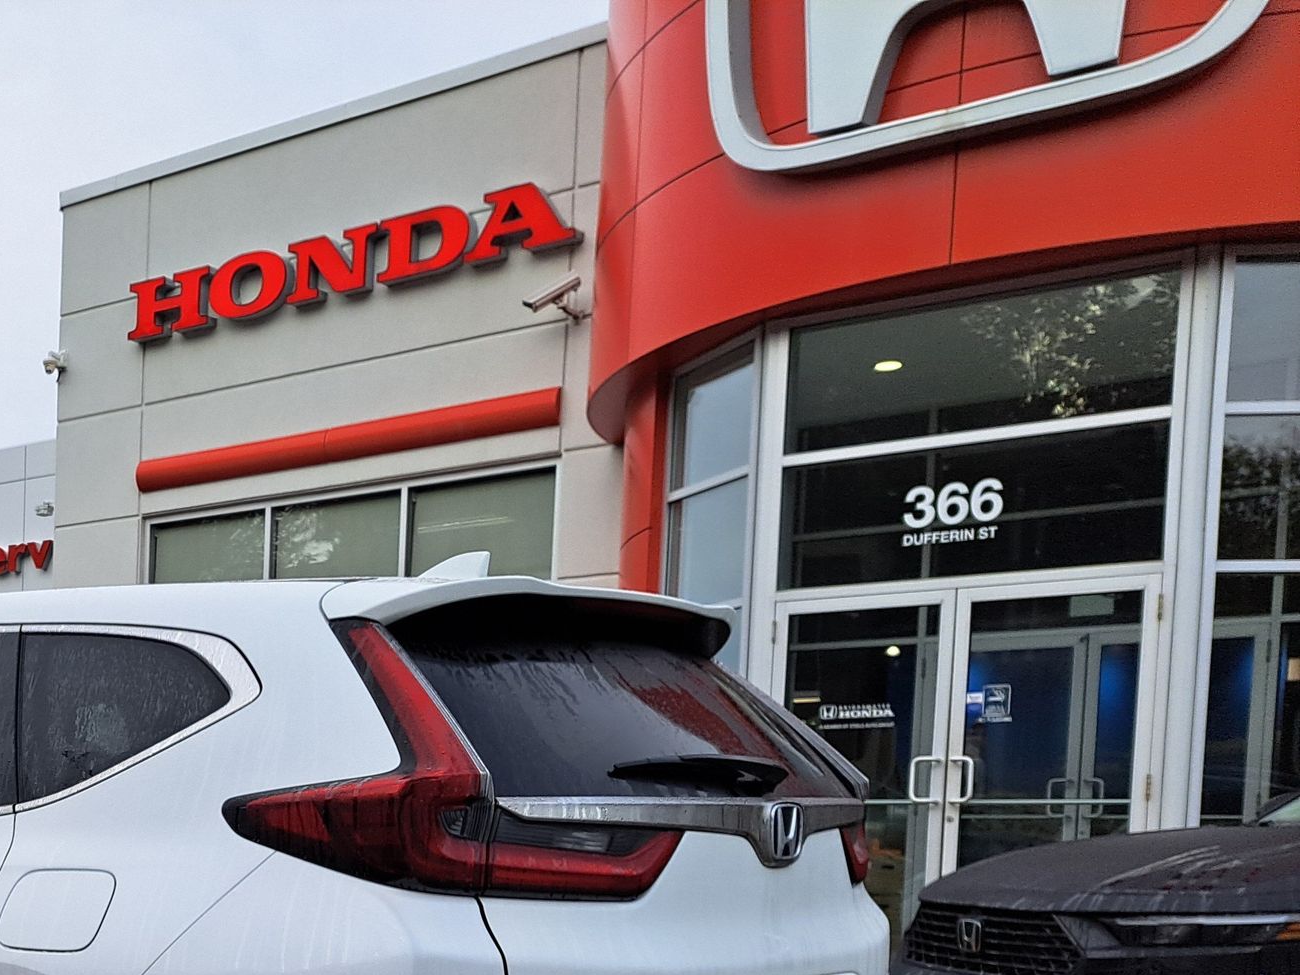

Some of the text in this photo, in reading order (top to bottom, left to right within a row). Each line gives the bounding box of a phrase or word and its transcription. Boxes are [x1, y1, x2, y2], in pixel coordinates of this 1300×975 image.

[128, 183, 584, 343] HONDA
[903, 477, 1004, 529] 366
[902, 525, 999, 547] DUFFERIN ST
[838, 709, 895, 719] HONDA
